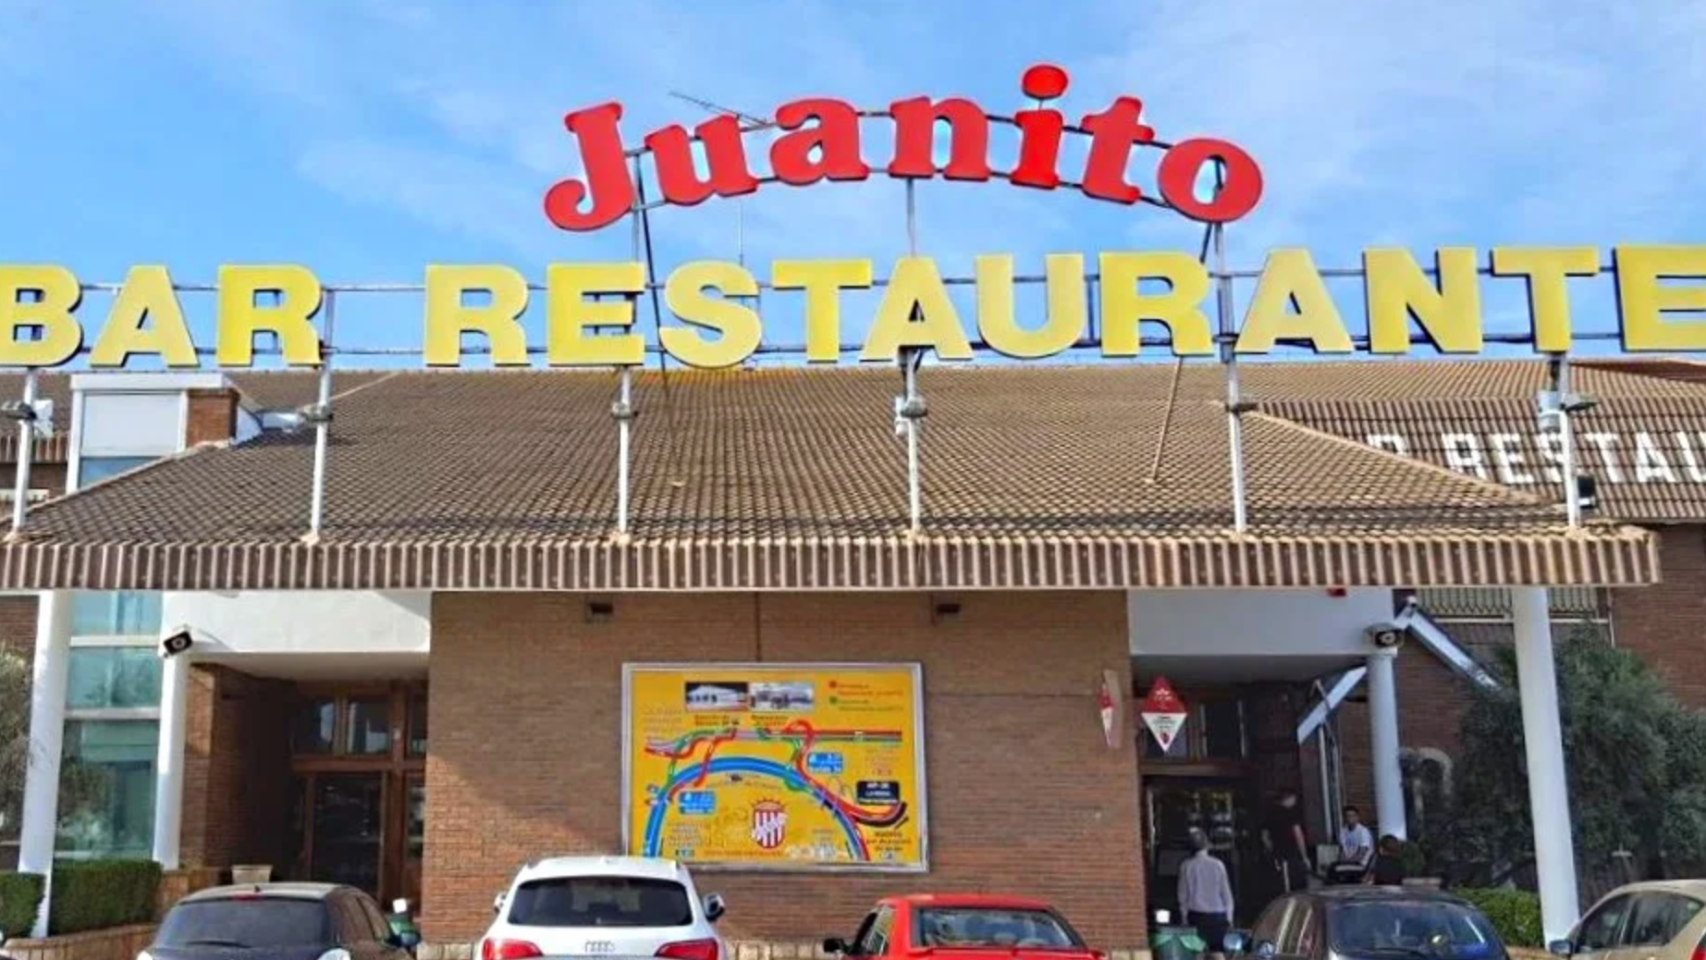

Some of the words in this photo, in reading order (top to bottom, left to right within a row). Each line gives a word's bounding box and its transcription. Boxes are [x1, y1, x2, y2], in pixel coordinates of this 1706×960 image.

[544, 63, 1263, 231] Juanito
[0, 264, 324, 368] BAR
[423, 245, 1706, 369] RESTAURANTE
